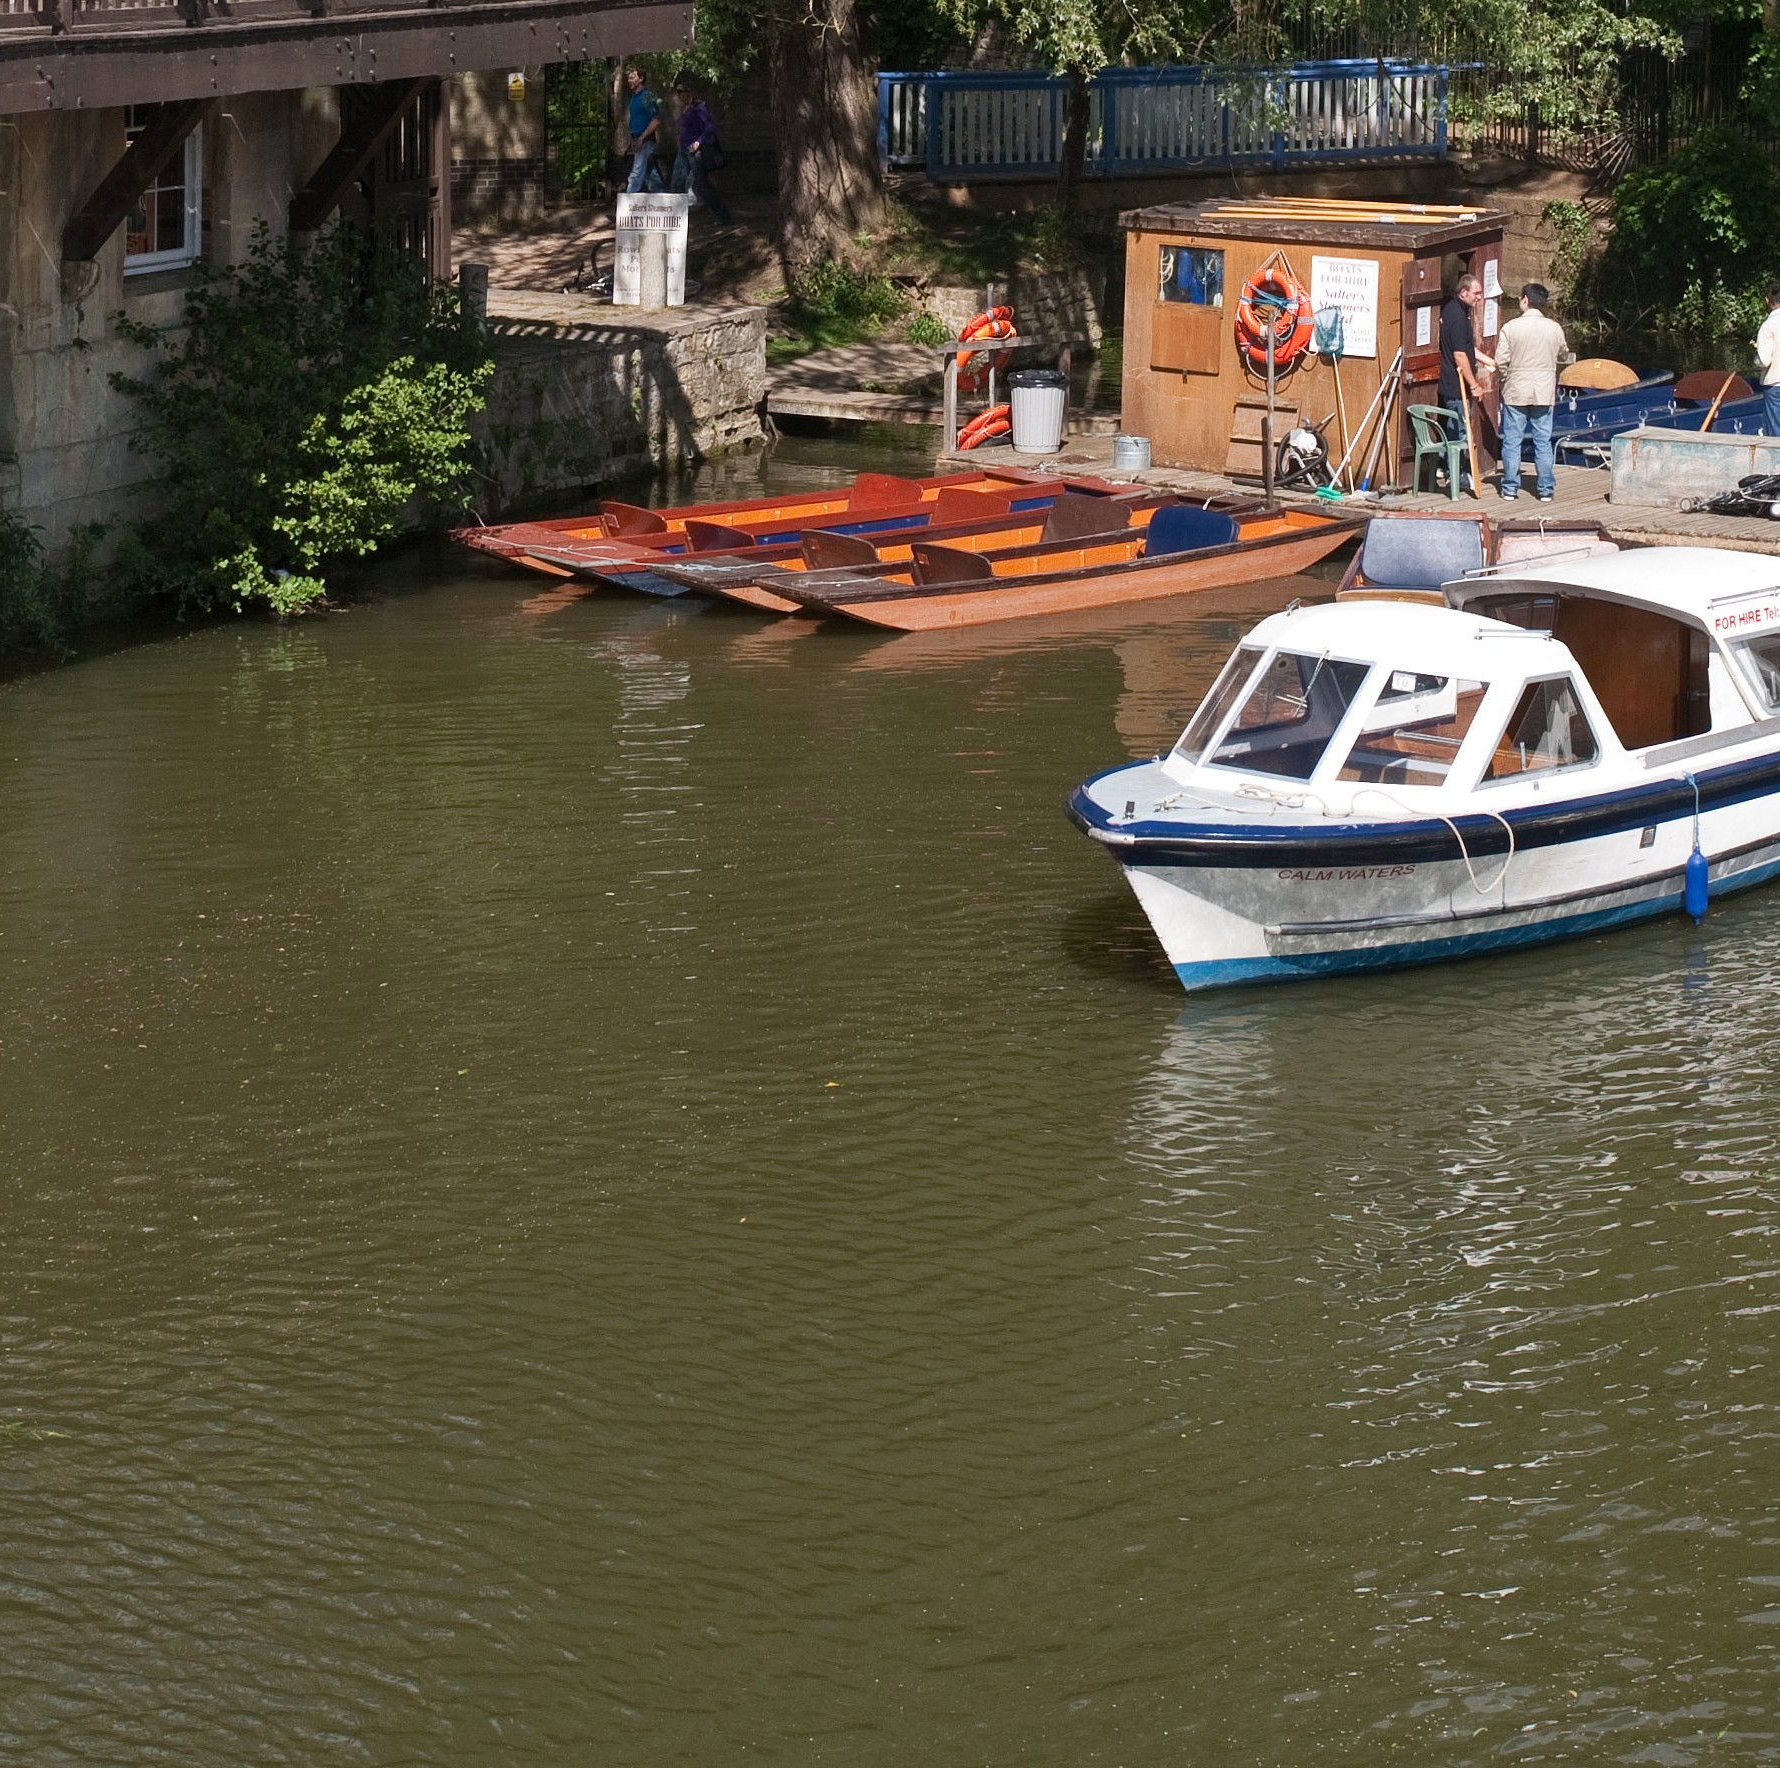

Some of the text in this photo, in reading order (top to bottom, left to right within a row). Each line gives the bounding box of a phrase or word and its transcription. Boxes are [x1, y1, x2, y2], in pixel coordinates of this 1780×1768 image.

[619, 215, 681, 228] BOATS FOR HIRE
[1329, 263, 1363, 274] BOATS
[1321, 274, 1341, 285] FOR
[1715, 605, 1780, 631] FOR HIRE Tel:
[1278, 864, 1417, 881] CALM WATERS
